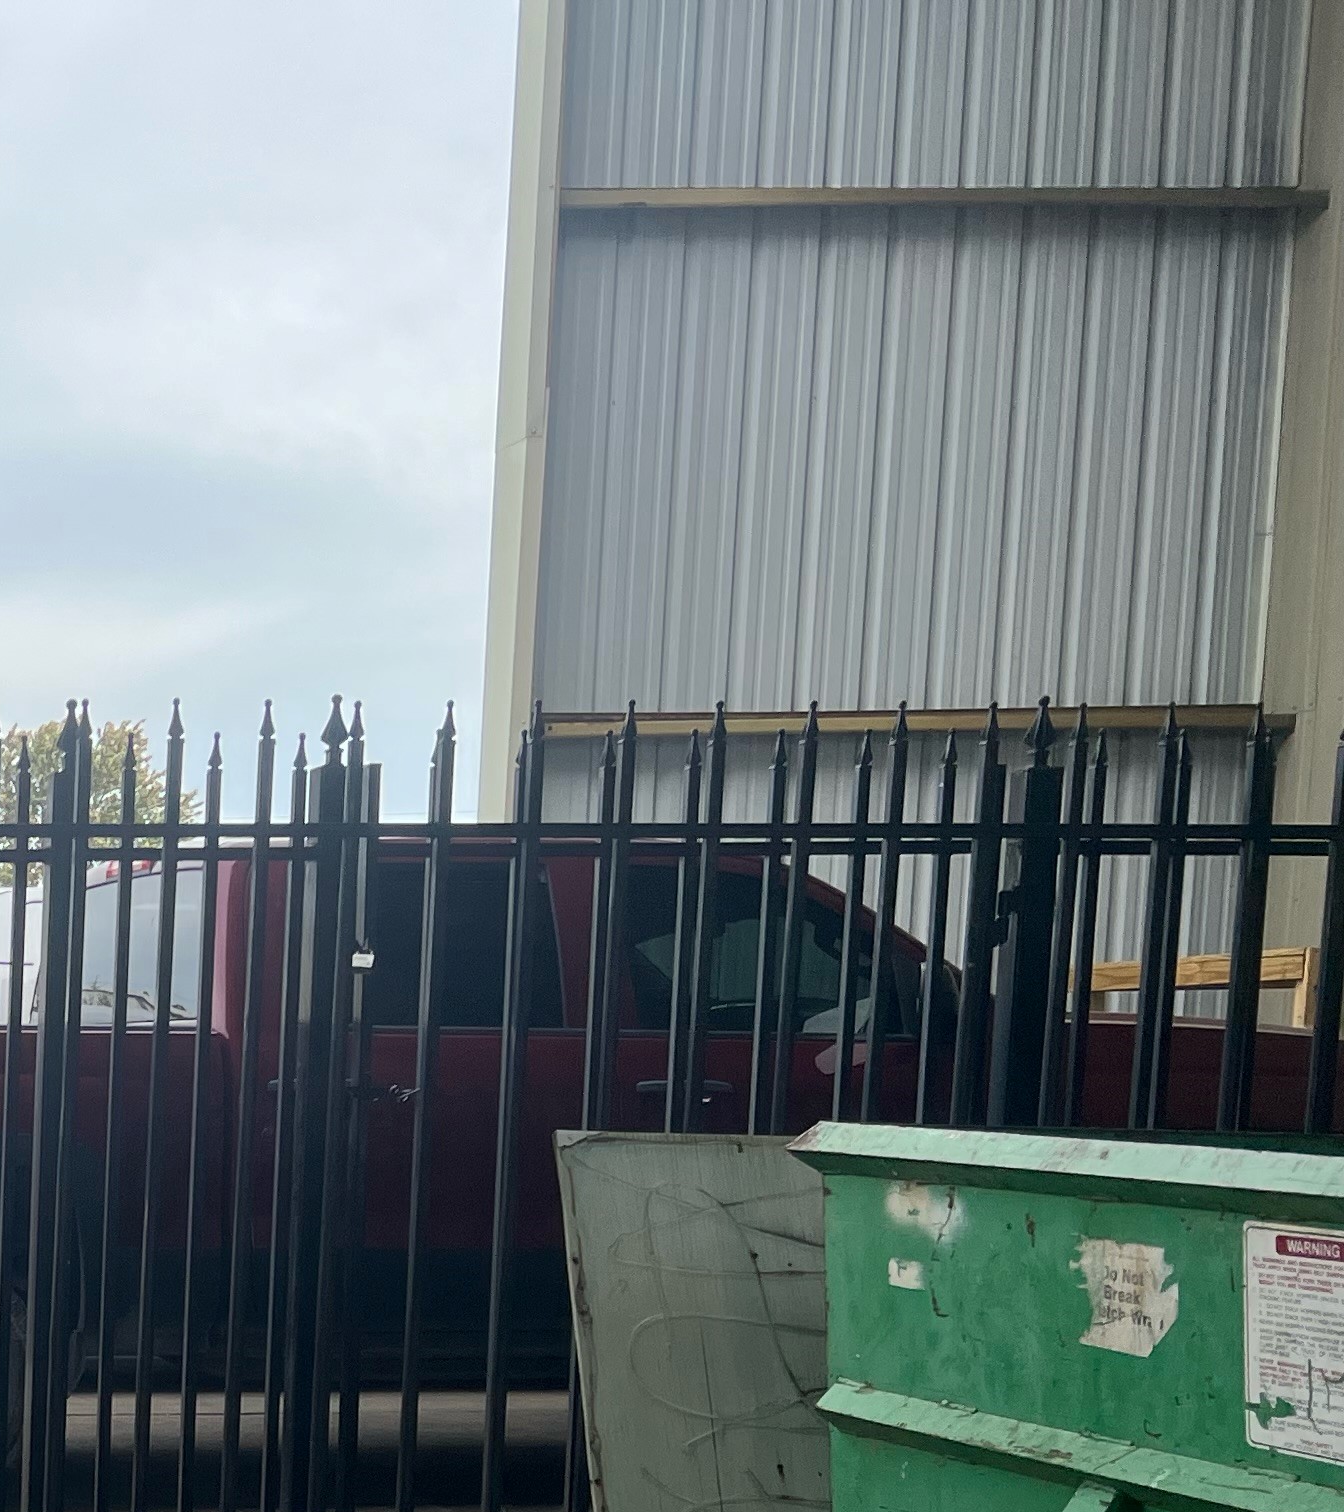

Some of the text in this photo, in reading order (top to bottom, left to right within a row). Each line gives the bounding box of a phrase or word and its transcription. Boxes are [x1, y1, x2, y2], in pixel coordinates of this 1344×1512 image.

[1286, 1239, 1341, 1259] WARNING
[1122, 1268, 1144, 1287] Not
[1104, 1284, 1141, 1305] Break
